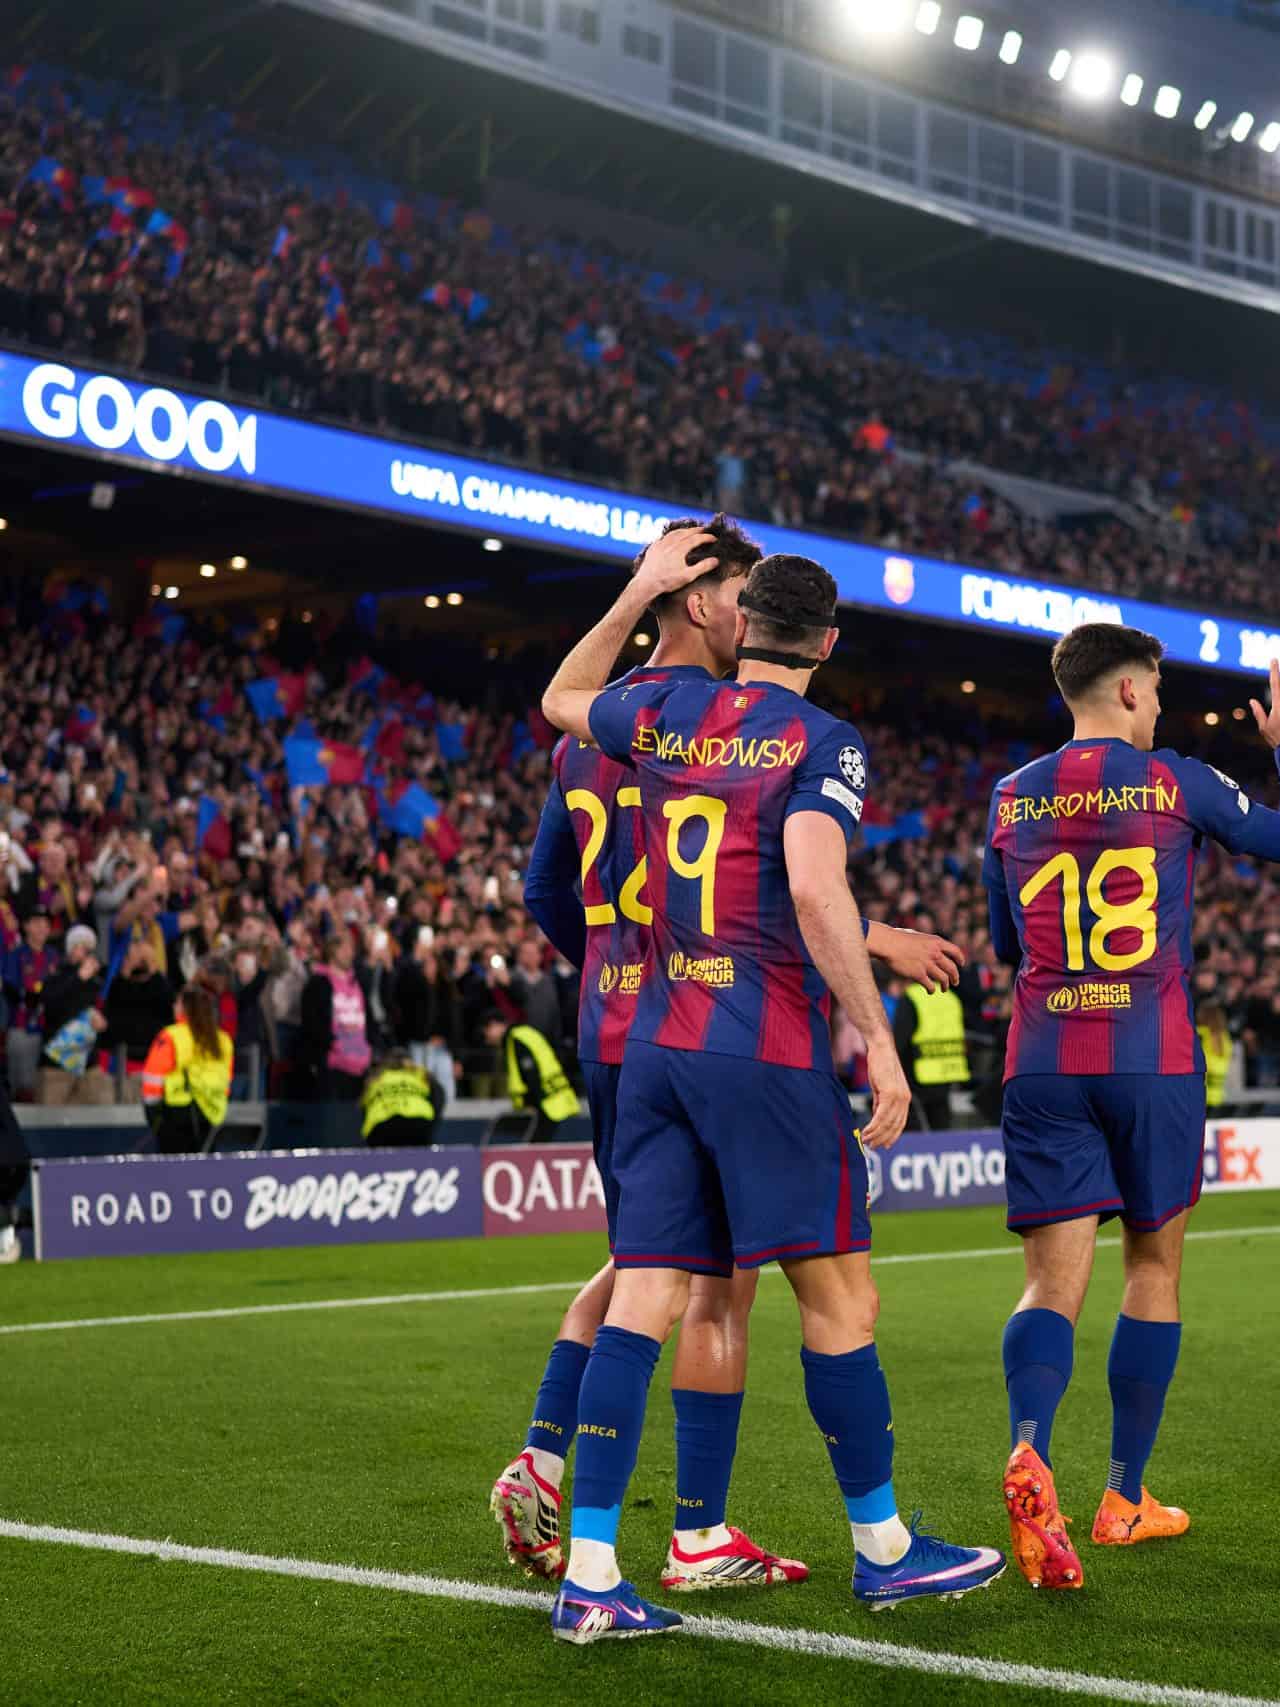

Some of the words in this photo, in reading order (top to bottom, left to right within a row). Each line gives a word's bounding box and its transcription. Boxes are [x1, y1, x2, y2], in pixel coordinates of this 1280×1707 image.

[391, 460, 460, 506] UEFA
[462, 476, 610, 536] CHAMPIONS
[1200, 619, 1220, 663] 2
[632, 724, 803, 767] EWANDOWSKI
[663, 795, 728, 936] 9
[1019, 846, 1159, 971] 18
[1079, 983, 1130, 995] UNHCR
[1081, 993, 1132, 1006] ACNUR
[890, 1143, 1007, 1198] crypto
[1203, 1127, 1263, 1184] dEx
[71, 1192, 172, 1228] ROAD
[187, 1187, 233, 1220] TO
[245, 1170, 416, 1230] BUDAPEST
[412, 1166, 459, 1216] 26
[483, 1158, 606, 1221] QATA
